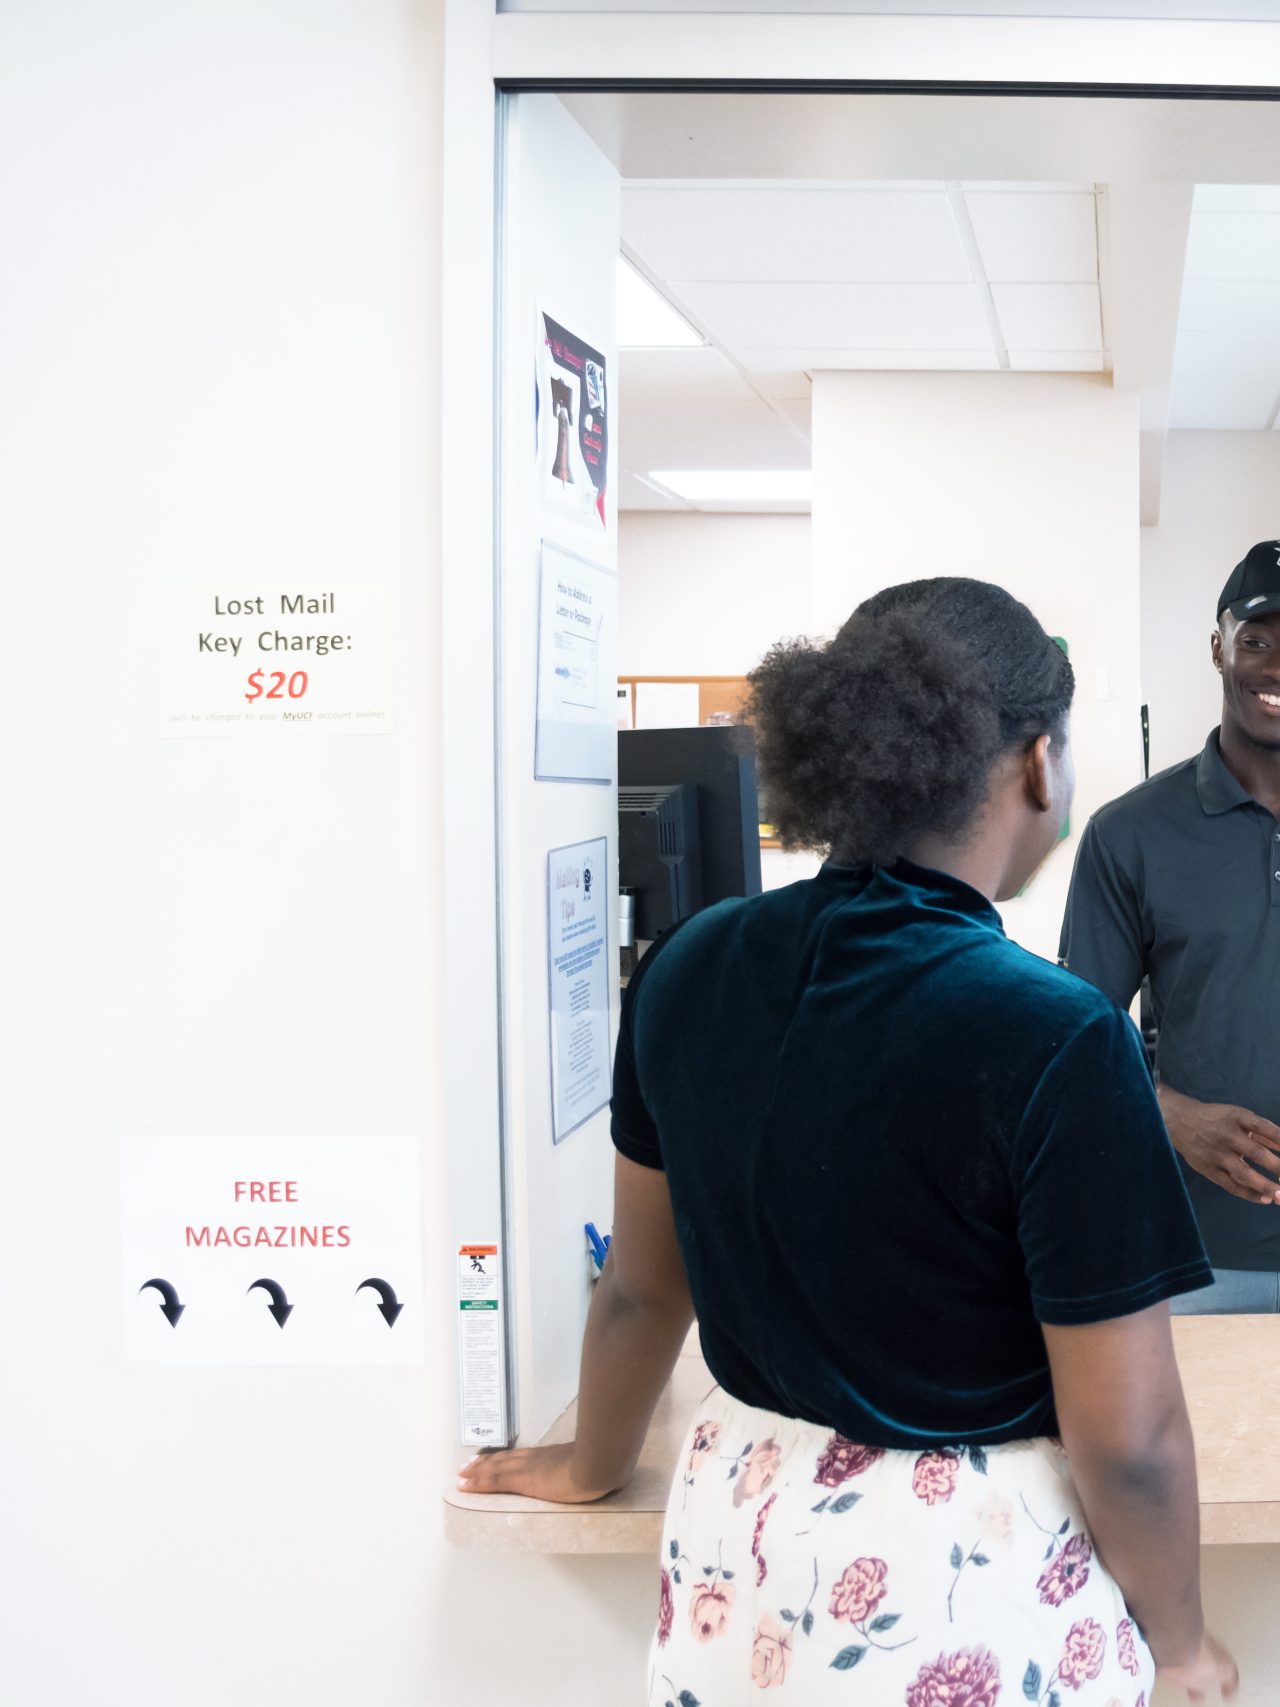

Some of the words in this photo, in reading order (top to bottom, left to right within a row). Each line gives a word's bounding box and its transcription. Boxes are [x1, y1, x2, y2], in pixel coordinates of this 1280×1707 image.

[214, 596, 264, 615] Lost
[281, 592, 334, 614] Mail
[199, 631, 242, 657] Key
[258, 630, 352, 656] Charge:
[245, 667, 309, 704] $20
[234, 1181, 298, 1202] FREE
[185, 1226, 351, 1248] MAGAZINES
